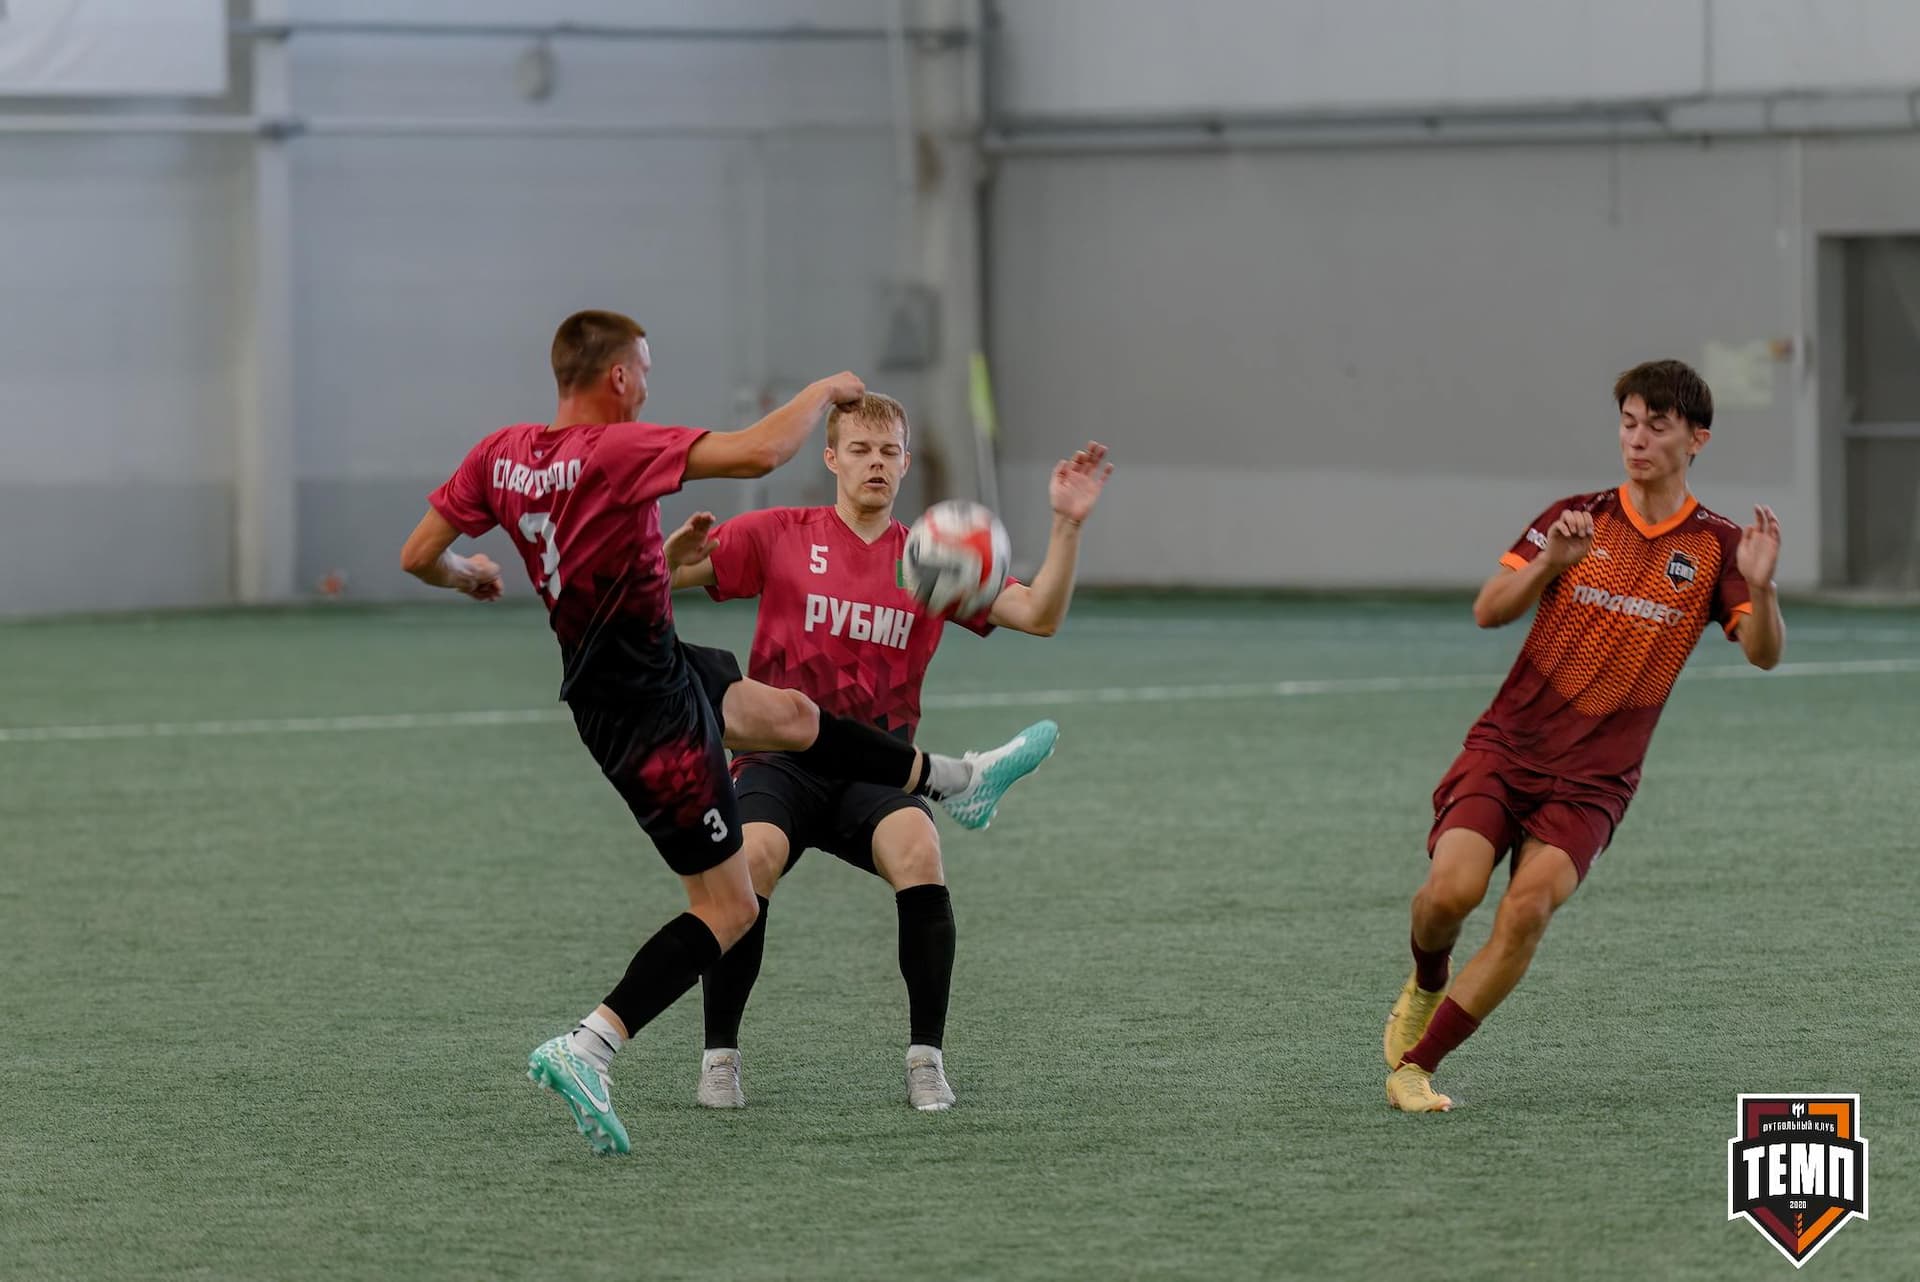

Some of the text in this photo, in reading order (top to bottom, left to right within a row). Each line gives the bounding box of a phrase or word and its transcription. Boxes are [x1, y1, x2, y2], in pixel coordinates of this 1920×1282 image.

[809, 543, 829, 574] 5
[804, 593, 915, 650] РУБИН
[703, 808, 728, 842] 3
